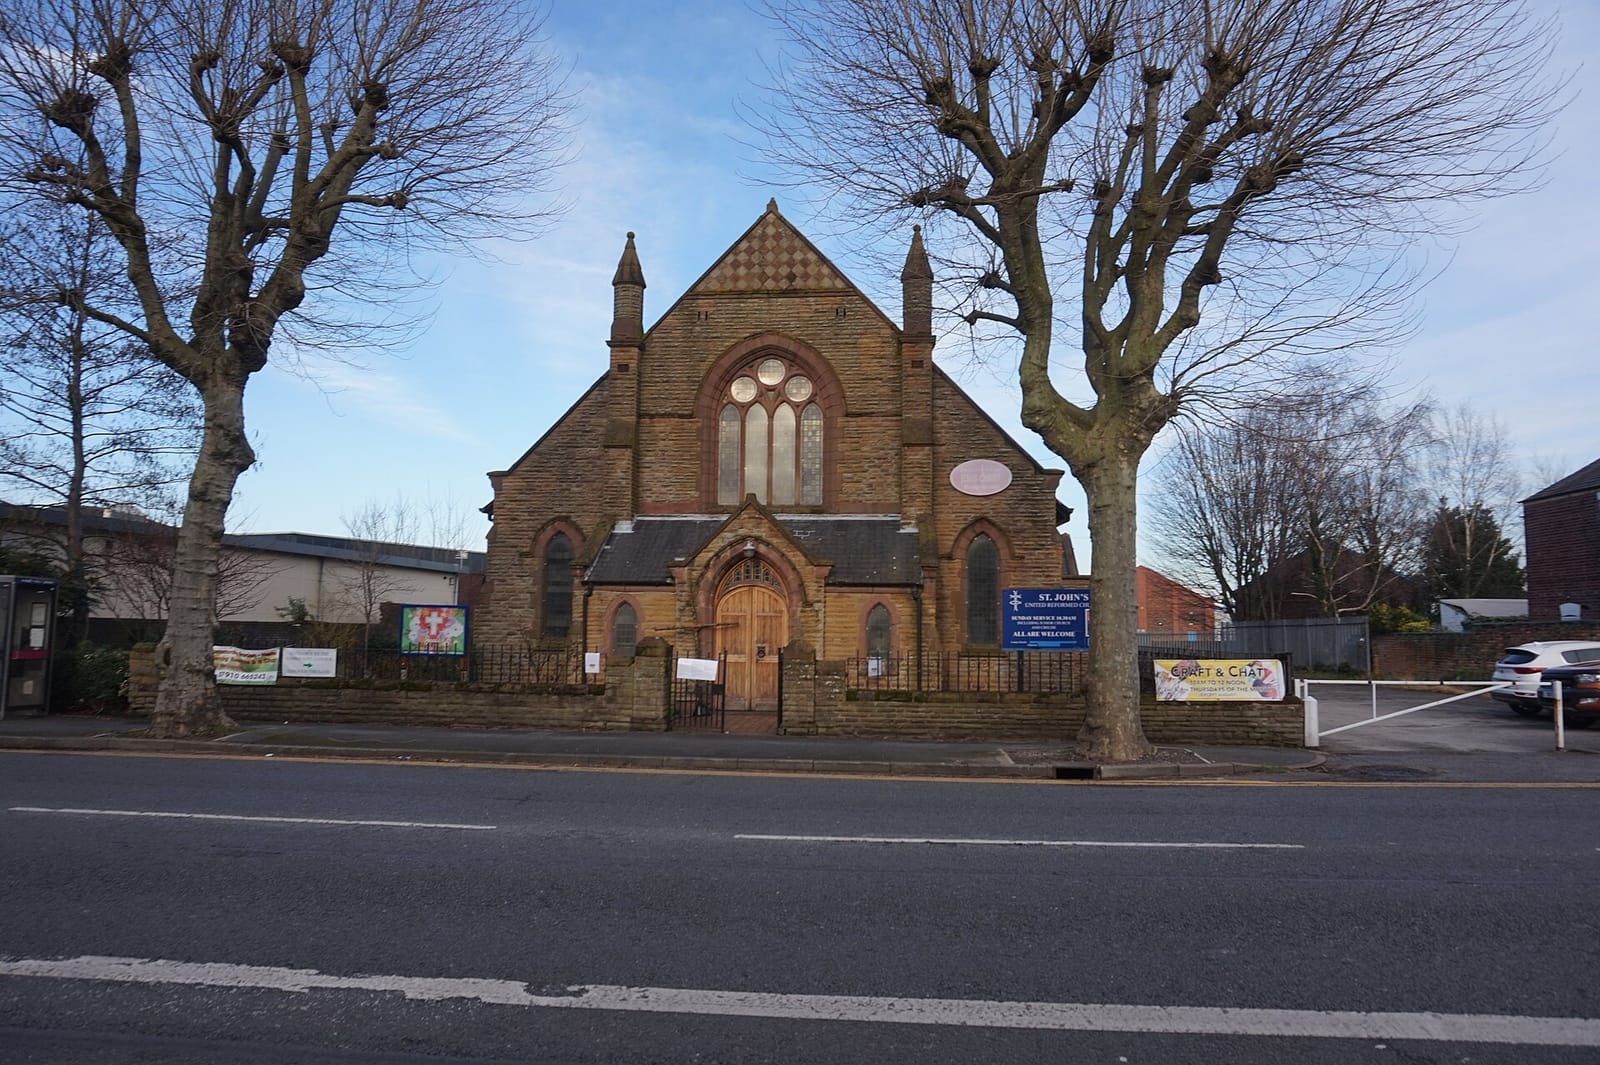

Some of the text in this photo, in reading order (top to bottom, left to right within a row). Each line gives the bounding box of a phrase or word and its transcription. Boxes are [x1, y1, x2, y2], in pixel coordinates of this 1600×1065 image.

[1038, 593, 1089, 601] ST. JOHN'S
[1170, 665, 1265, 677] CRAFT & CHAT
